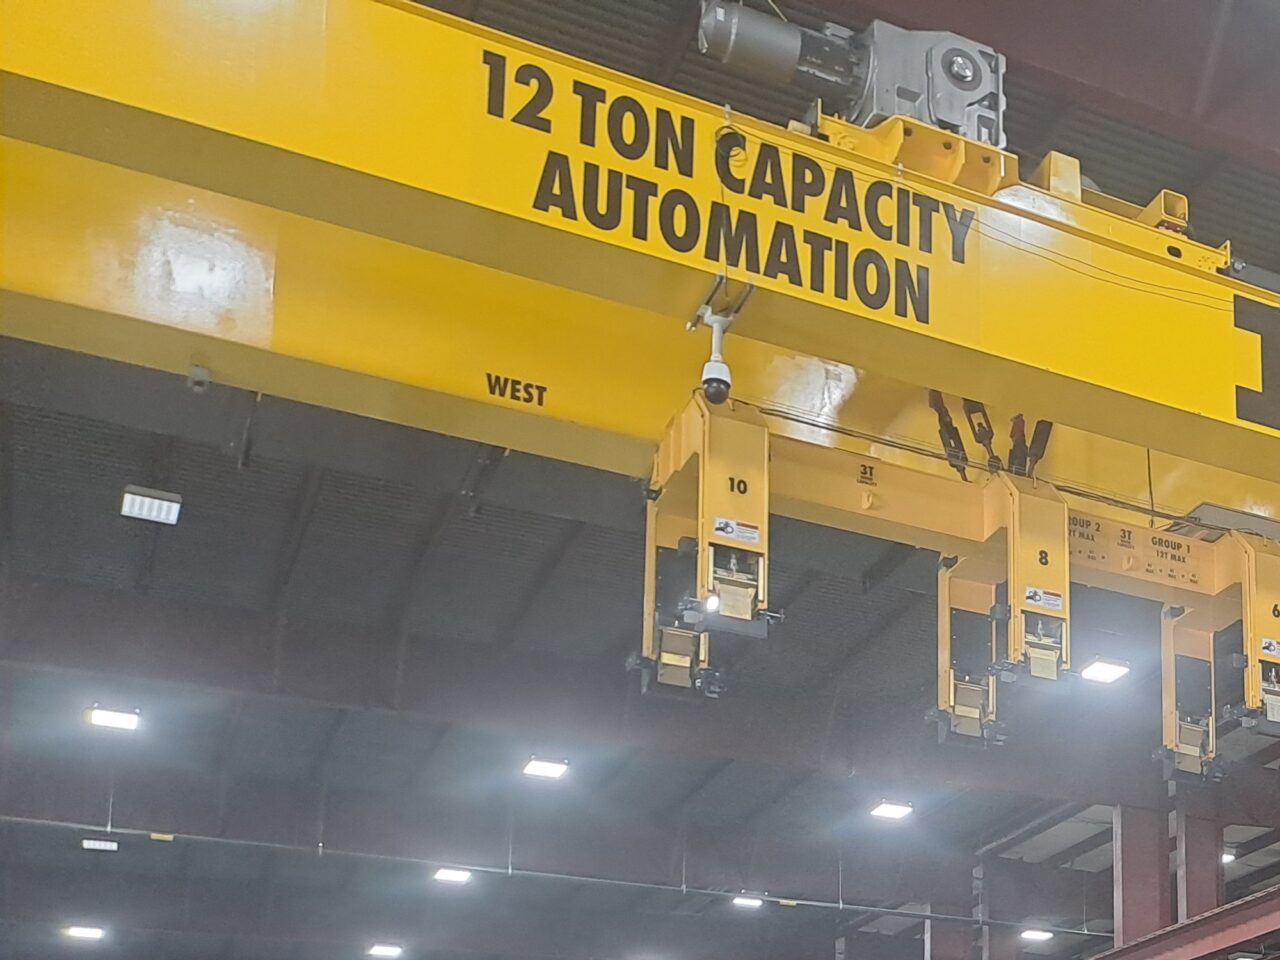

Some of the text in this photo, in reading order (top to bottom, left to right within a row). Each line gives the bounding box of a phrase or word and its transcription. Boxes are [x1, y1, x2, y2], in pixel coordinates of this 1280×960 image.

[483, 50, 974, 264] 12 TON CAPACITY
[533, 151, 930, 324] AUTOMATION
[487, 373, 547, 406] WEST
[860, 464, 875, 477] 3T
[728, 477, 748, 495] 10
[1094, 521, 1101, 532] 2
[1151, 536, 1191, 554] GROUP 1
[1038, 550, 1049, 566] 8
[1272, 603, 1280, 619] 6
